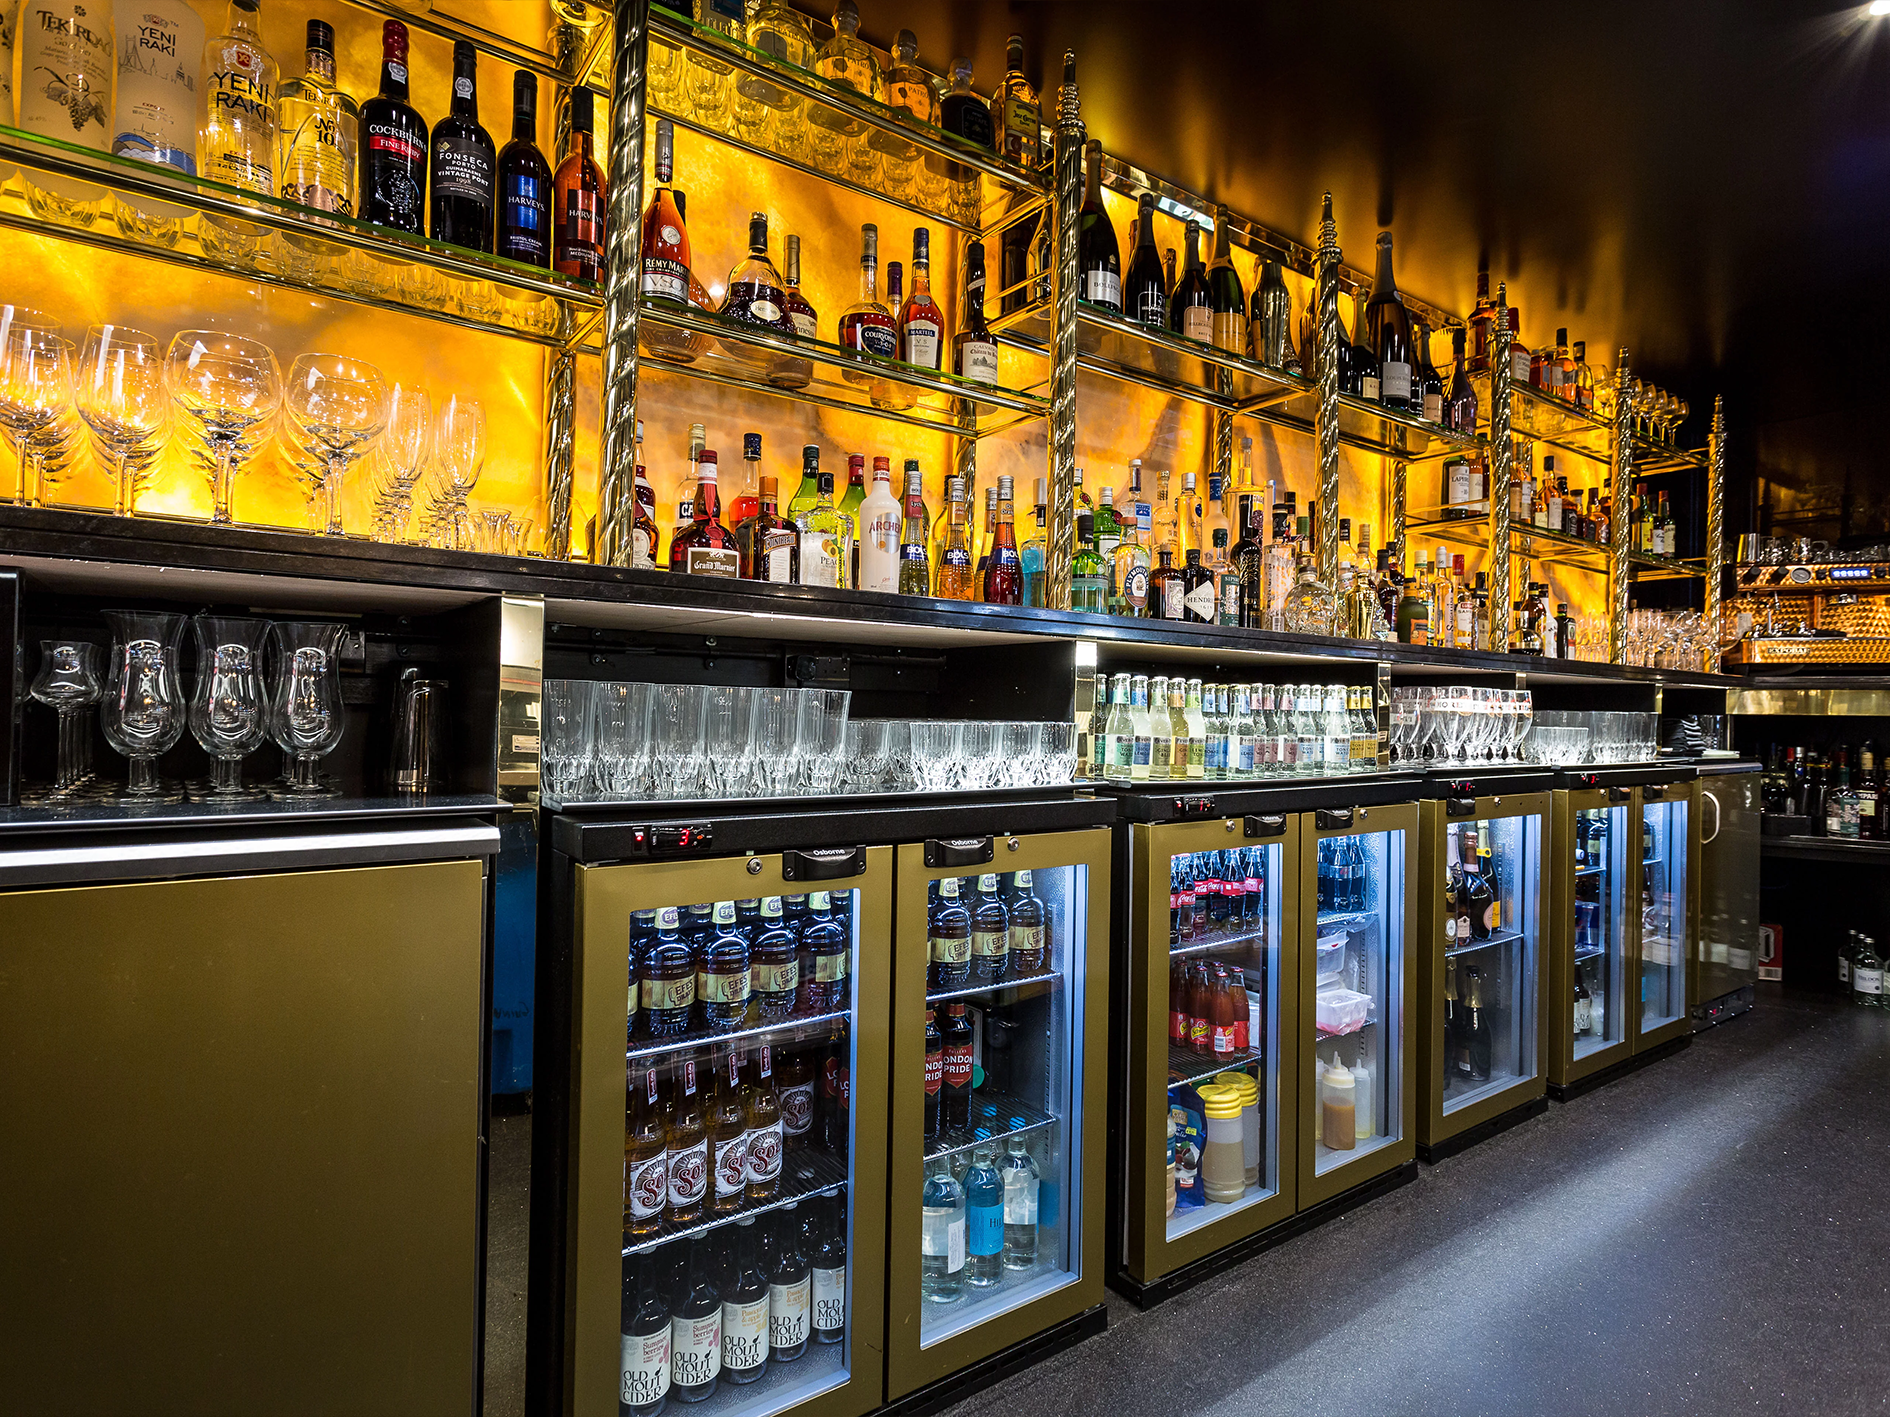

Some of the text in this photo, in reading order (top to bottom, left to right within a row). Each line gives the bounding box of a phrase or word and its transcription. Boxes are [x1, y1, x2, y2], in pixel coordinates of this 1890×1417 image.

[139, 38, 175, 57] RAKI
[216, 92, 267, 122] RAKI
[316, 130, 334, 146] 10
[380, 139, 401, 151] FINE
[439, 152, 488, 170] FONSECA
[452, 160, 476, 170] PORTO
[438, 170, 489, 187] VINTAGE PORT
[508, 196, 545, 212] HARVEYS
[569, 209, 603, 226] HARVYS
[947, 550, 969, 560] BOLS
[694, 560, 713, 570] Grand
[679, 829, 690, 846] 3
[780, 966, 797, 980] EFES
[676, 980, 693, 995] EFES
[728, 974, 747, 990] EFES
[943, 1056, 972, 1064] ONDON
[925, 1070, 942, 1082] RIDE
[944, 1064, 970, 1074] PRIDE
[726, 1153, 746, 1185] SO
[641, 1174, 665, 1207] SO
[818, 1298, 840, 1309] OLD
[818, 1307, 844, 1318] MOU
[692, 1320, 716, 1332] Summer
[770, 1316, 791, 1326] OLD
[817, 1317, 844, 1328] CIDE
[693, 1328, 714, 1339] berries
[770, 1322, 803, 1336] MOUT
[643, 1336, 667, 1350] Summer
[723, 1335, 746, 1347] OLD
[770, 1333, 803, 1345] CIDER
[643, 1344, 664, 1356] berries
[724, 1341, 760, 1356] MOUT
[674, 1352, 698, 1363] OLD
[674, 1356, 712, 1373] MOUT
[723, 1354, 760, 1367] CIDER
[623, 1370, 648, 1382] OLD
[624, 1374, 662, 1392] MOUT
[674, 1369, 711, 1384] CIDER
[622, 1386, 661, 1403] CIDER
